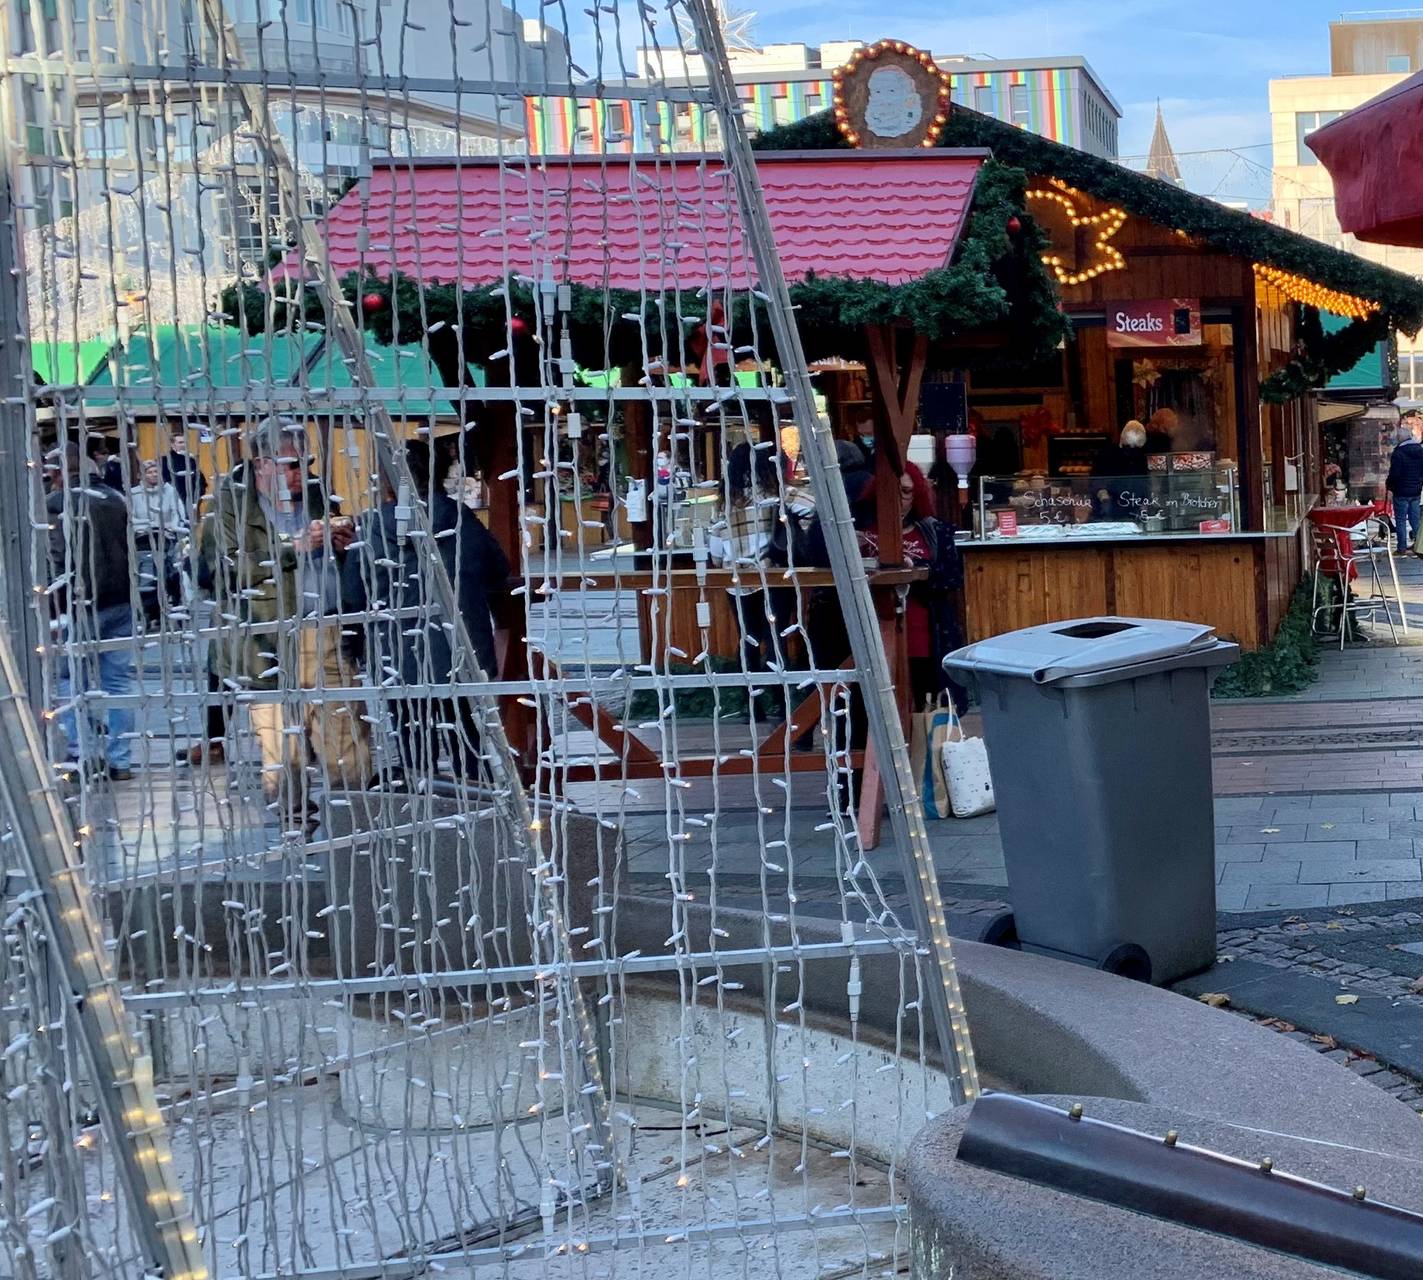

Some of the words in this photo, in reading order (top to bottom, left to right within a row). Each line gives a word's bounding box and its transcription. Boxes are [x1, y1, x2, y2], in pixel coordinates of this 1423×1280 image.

[1115, 311, 1163, 332] Steaks
[1120, 490, 1160, 507] Steak
[1040, 511, 1051, 524] 5
